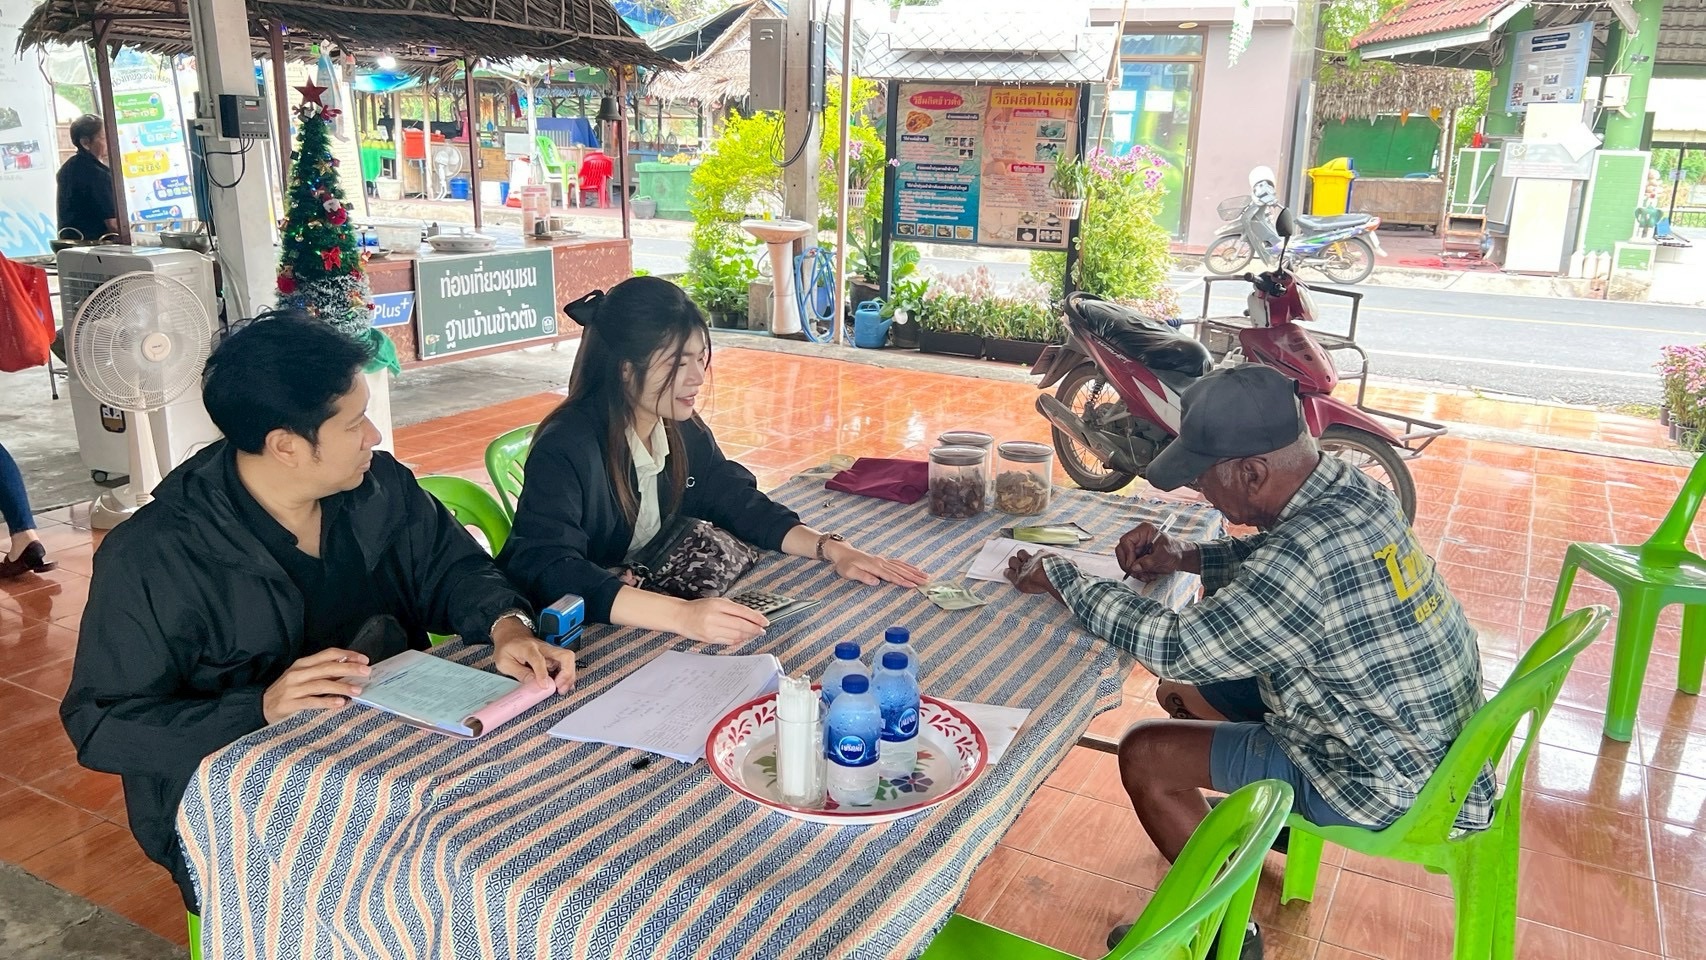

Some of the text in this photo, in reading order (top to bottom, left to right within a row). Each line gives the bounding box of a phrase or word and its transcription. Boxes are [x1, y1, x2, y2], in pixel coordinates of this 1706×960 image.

[995, 91, 1073, 106] วิธีผลิตไข่เค็ม
[440, 260, 537, 299] ท่องเที่ยวชุมชน
[445, 303, 537, 349] ฐานบ้านข้าวตัง
